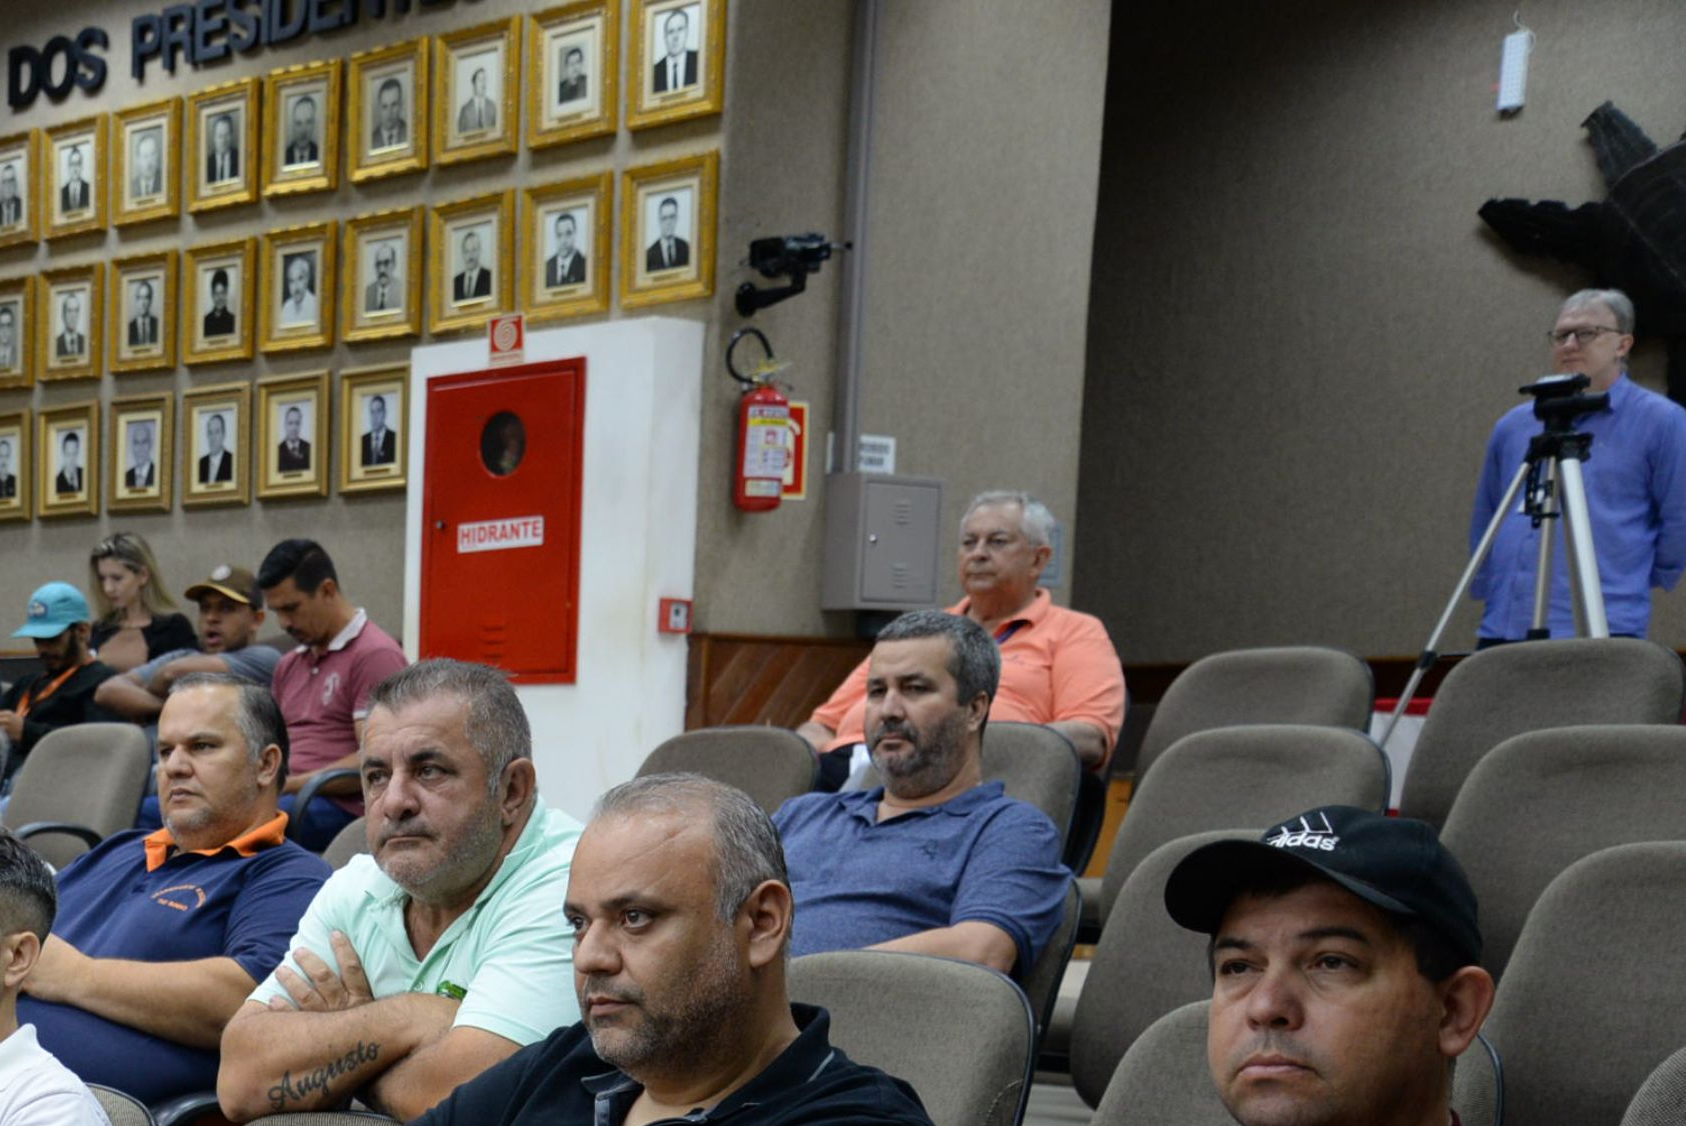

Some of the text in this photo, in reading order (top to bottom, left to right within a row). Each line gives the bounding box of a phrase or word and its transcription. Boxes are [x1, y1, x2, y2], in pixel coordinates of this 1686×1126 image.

[8, 27, 109, 107] DOS
[460, 520, 541, 546] HIDRANTE
[267, 1040, 381, 1110] Augusto
